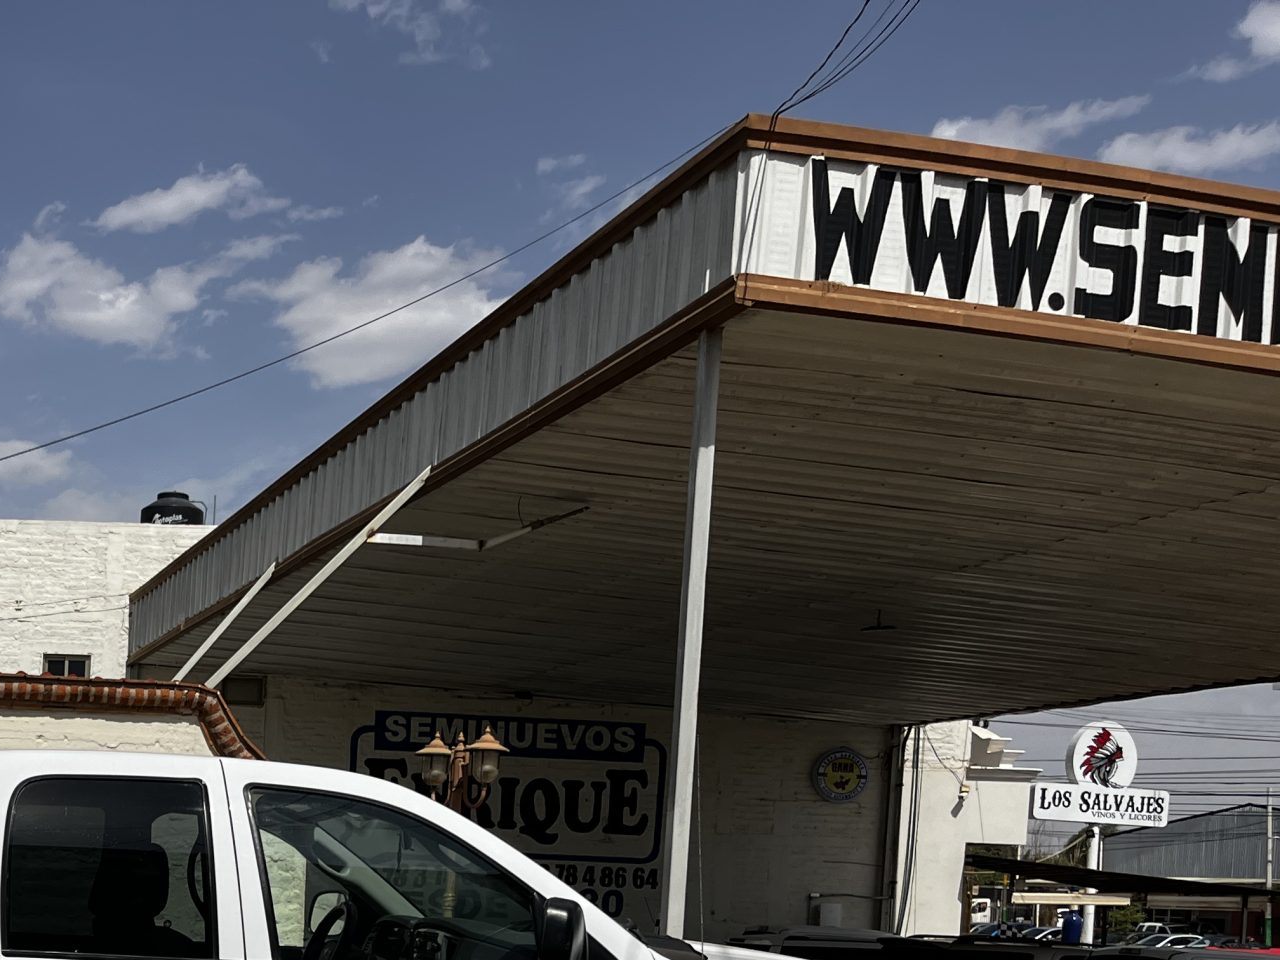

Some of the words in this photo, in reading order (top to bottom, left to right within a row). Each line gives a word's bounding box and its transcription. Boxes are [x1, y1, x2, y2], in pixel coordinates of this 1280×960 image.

[385, 715, 636, 752] SEMINUEVOS
[365, 758, 649, 845] RIQUE
[1039, 788, 1072, 810] LOS
[1079, 791, 1165, 814] SALVAJES
[1091, 810, 1116, 819] VINOS
[1120, 812, 1126, 820] Y
[1129, 813, 1163, 822] LICORES
[582, 865, 596, 887] 4
[600, 866, 627, 888] 86
[632, 866, 658, 889] 64
